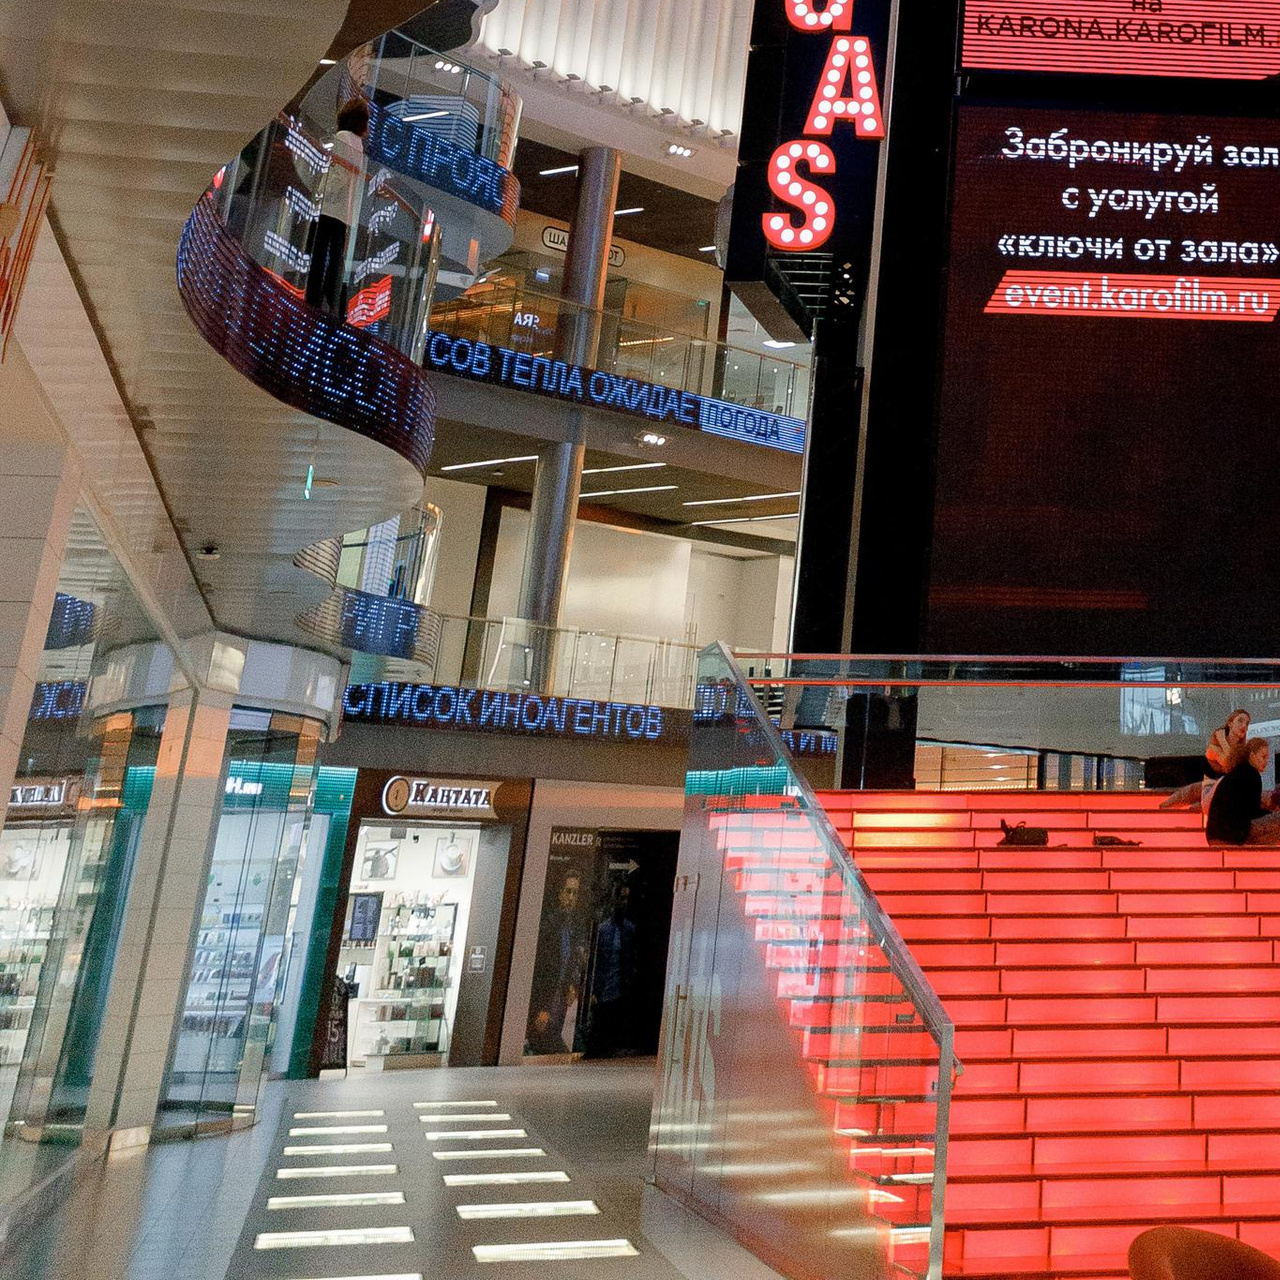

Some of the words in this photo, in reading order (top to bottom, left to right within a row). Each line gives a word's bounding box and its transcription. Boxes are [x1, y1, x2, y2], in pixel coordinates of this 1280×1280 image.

[1002, 127, 1213, 172] Забронируй
[1223, 144, 1279, 167] зал
[1062, 187, 1079, 209] с
[1088, 183, 1219, 220] услугой
[998, 234, 1123, 261] «ключи
[1134, 239, 1171, 261] от
[1181, 240, 1280, 264] зала»
[1005, 276, 1269, 314] event.karofilm.ru
[498, 347, 583, 401] ТЕПЛА
[589, 371, 700, 423] ОЖИДАЕ
[708, 403, 780, 441] ПОГОДА
[343, 681, 477, 726] СПИСОК
[480, 690, 664, 740] ИНОАГЕНТОВ
[552, 832, 594, 846] KANZLER
